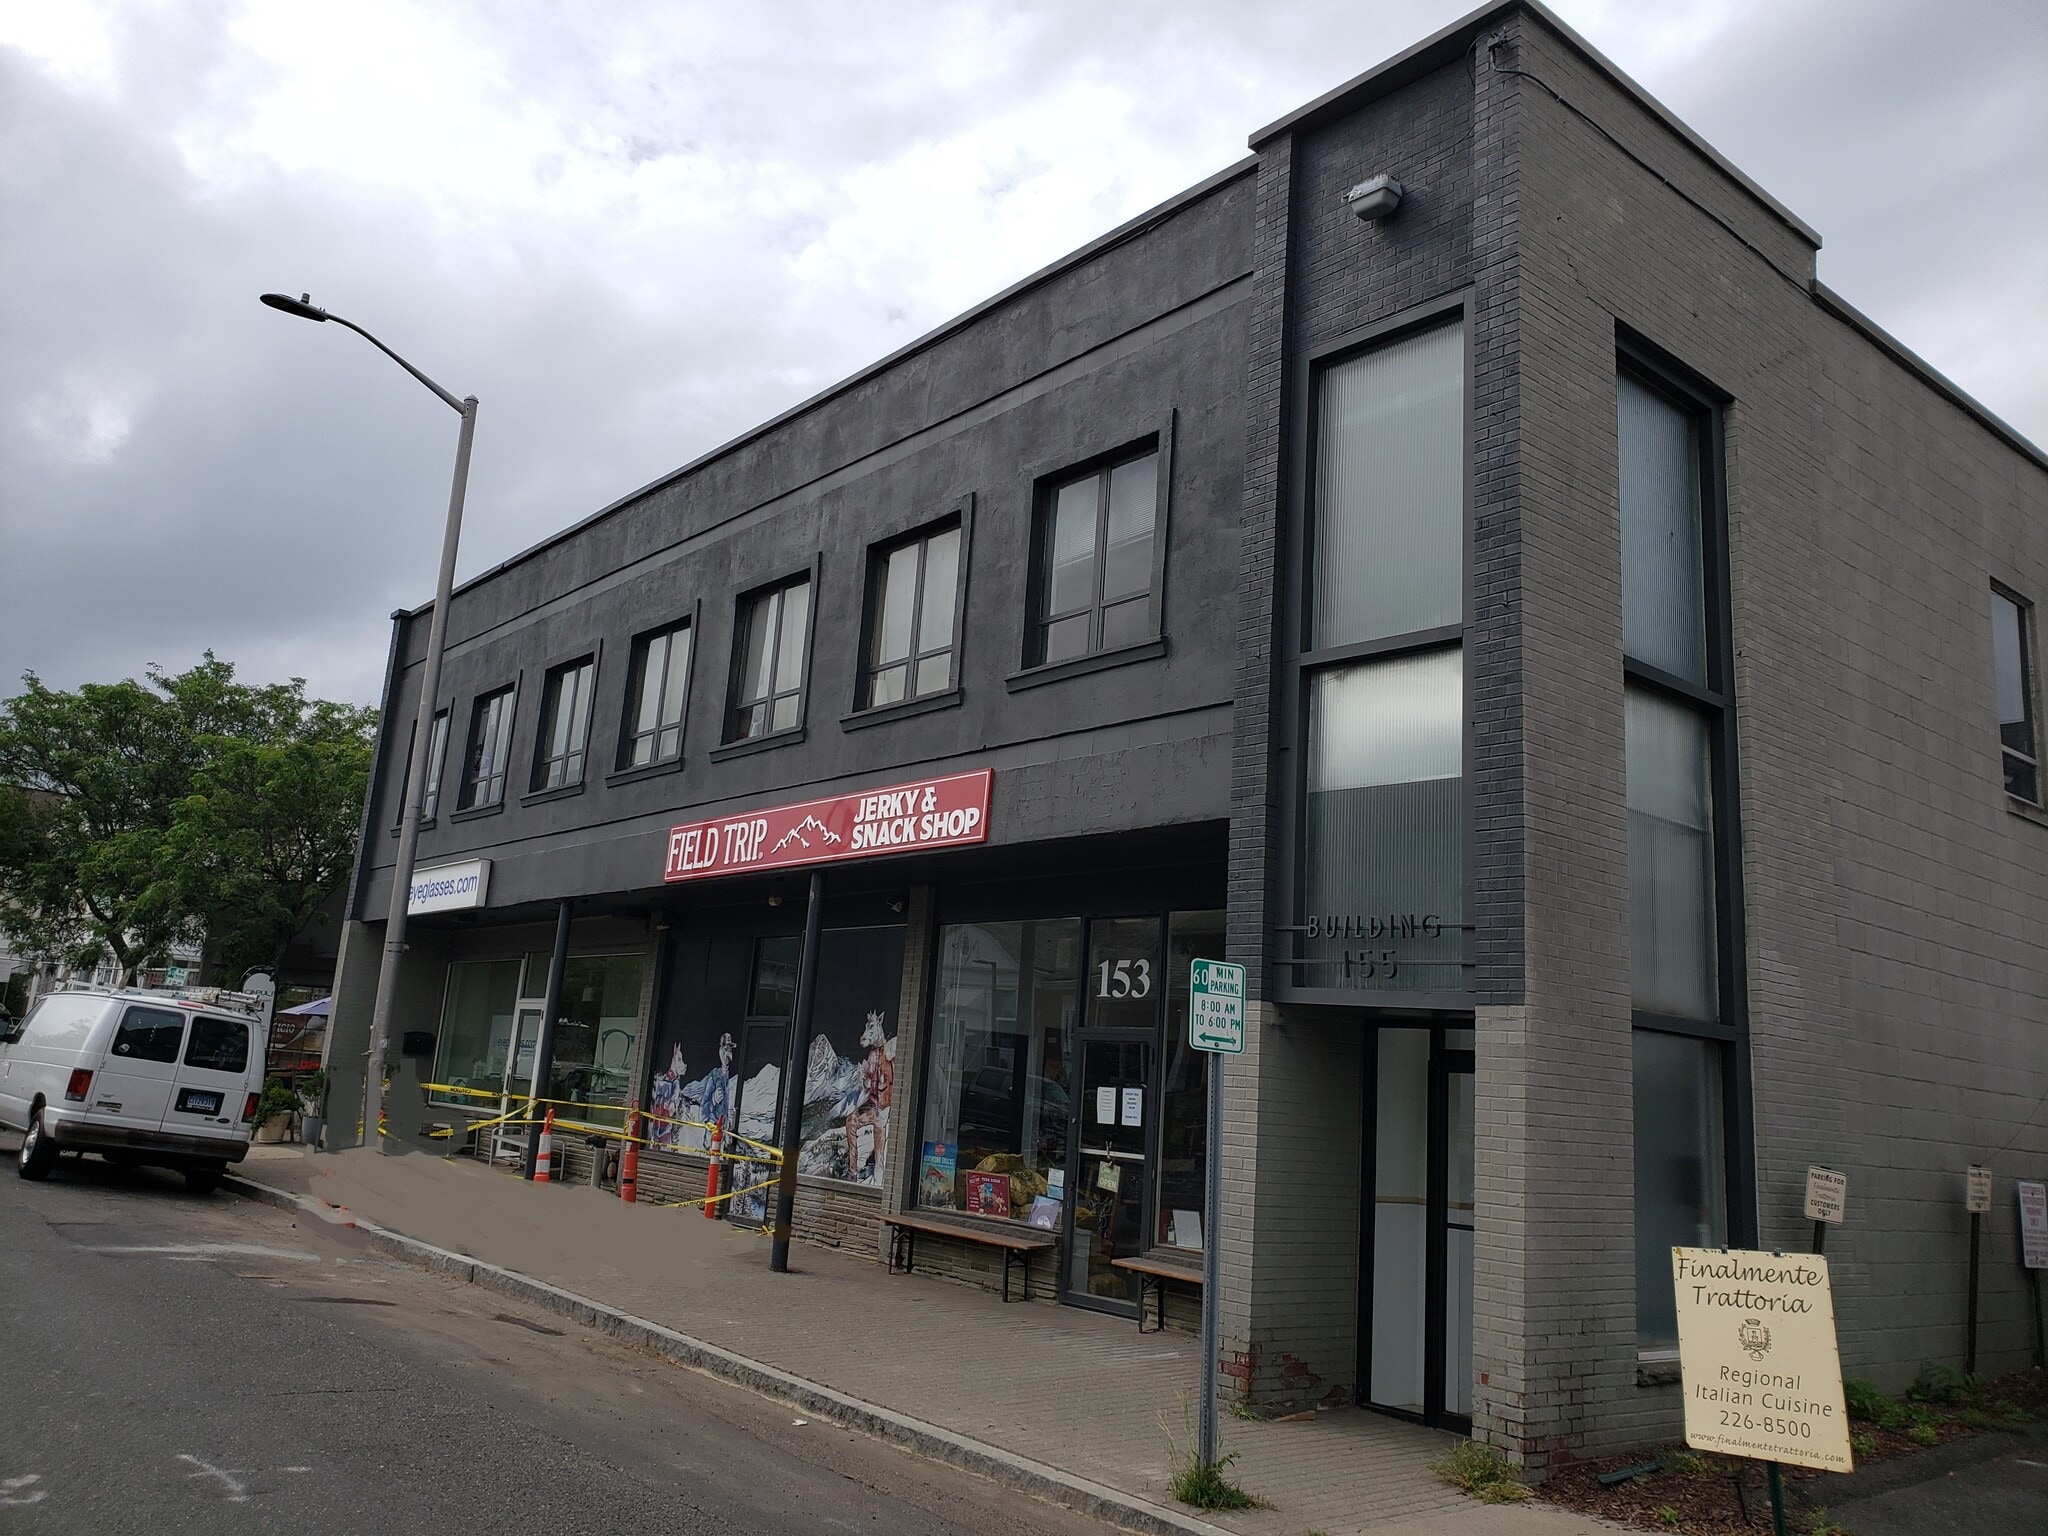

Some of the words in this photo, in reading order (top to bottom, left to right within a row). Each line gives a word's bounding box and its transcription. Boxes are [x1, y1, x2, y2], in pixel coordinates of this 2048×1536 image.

[854, 788, 921, 823] JERKY
[921, 786, 937, 813] &
[851, 817, 917, 850] SNACK
[920, 807, 980, 841] SHOP
[667, 828, 719, 872] FIELD
[723, 818, 768, 865] TRIP
[1306, 913, 1442, 939] BUILDING
[1193, 968, 1209, 986] 60
[1216, 967, 1234, 980] MIN
[1343, 949, 1398, 979] 155
[1096, 958, 1151, 998] 153
[1210, 981, 1239, 995] PARKING
[1201, 999, 1220, 1012] 8:00
[1224, 1003, 1236, 1015] AM
[1195, 1014, 1205, 1025] TO
[1208, 1016, 1226, 1029] 6:00
[1230, 1018, 1241, 1030] PM
[1099, 1178, 1117, 1189] OPEN
[1811, 1172, 1833, 1183] PARKING
[1833, 1177, 1845, 1186] FOR
[1810, 1199, 1840, 1211] CUSTOMERS
[1817, 1208, 1831, 1217] ONLY
[1678, 1258, 1824, 1286] Finalmente
[1692, 1285, 1813, 1314] Trattoria
[1720, 1365, 1801, 1390] Regional
[1695, 1384, 1753, 1406] Italian
[1762, 1393, 1833, 1417] Cuisine
[1720, 1410, 1811, 1439] 226-8500
[1690, 1431, 1847, 1464] www.finalmentetrattoria.com
